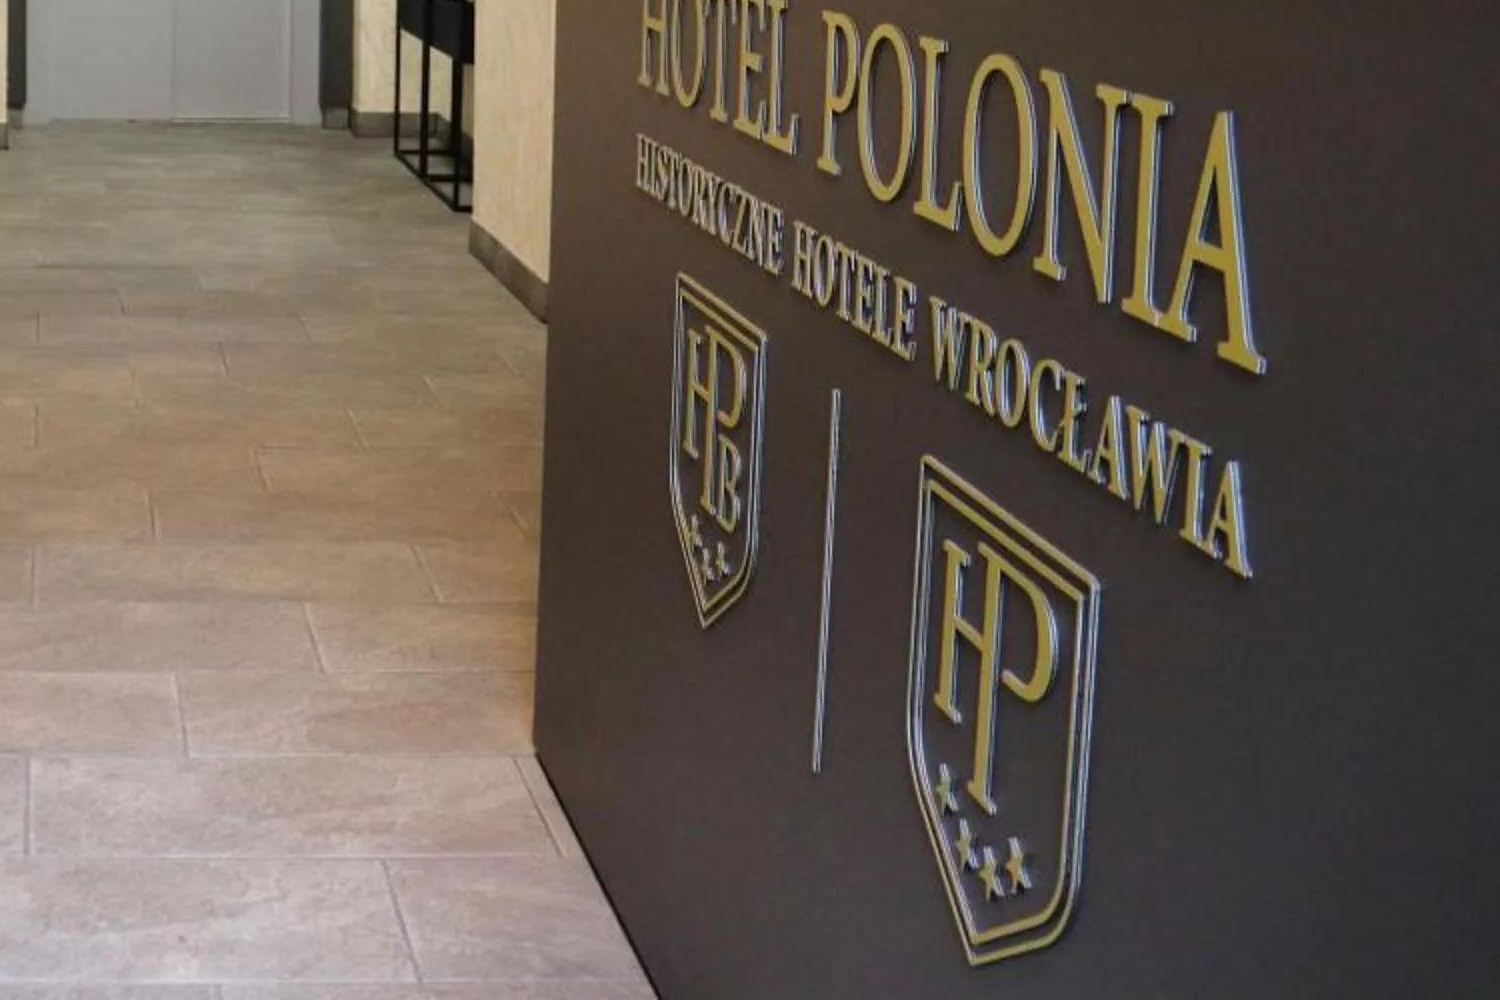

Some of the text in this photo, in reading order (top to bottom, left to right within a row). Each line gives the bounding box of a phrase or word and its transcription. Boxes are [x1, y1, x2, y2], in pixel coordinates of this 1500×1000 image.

[635, 133, 1253, 578] HISTORYCZNE HOTELE WROCŁAWIA
[816, 8, 1267, 375] POLONIA
